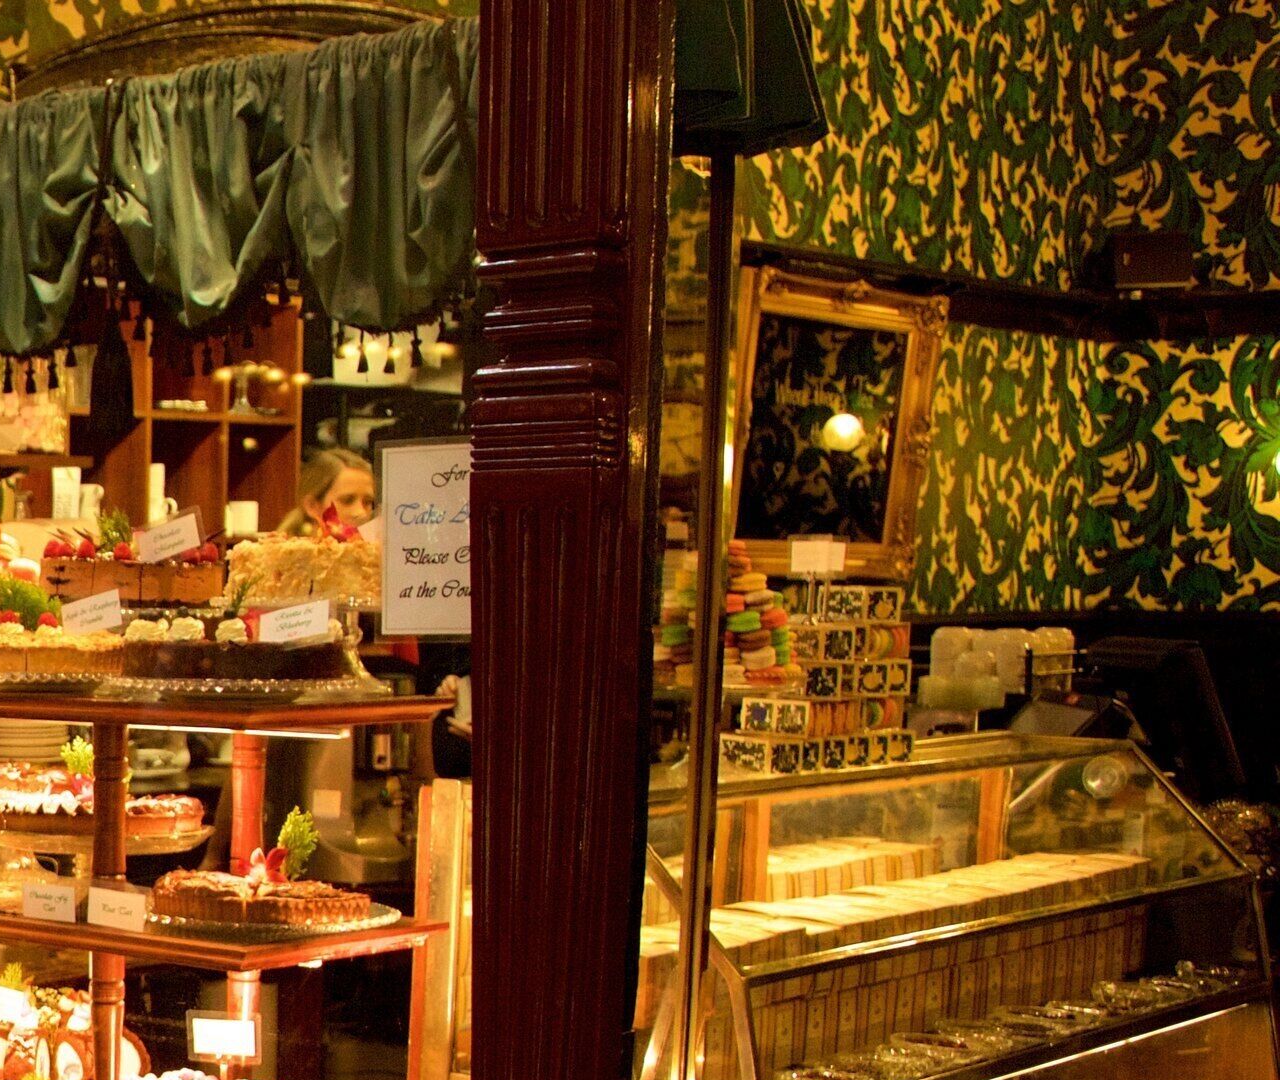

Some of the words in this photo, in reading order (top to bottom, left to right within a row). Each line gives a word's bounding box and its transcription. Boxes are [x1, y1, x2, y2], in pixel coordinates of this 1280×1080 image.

[431, 464, 470, 487] For
[394, 503, 446, 525] Take
[402, 546, 450, 565] Please
[399, 585, 413, 599] at
[416, 581, 437, 598] the
